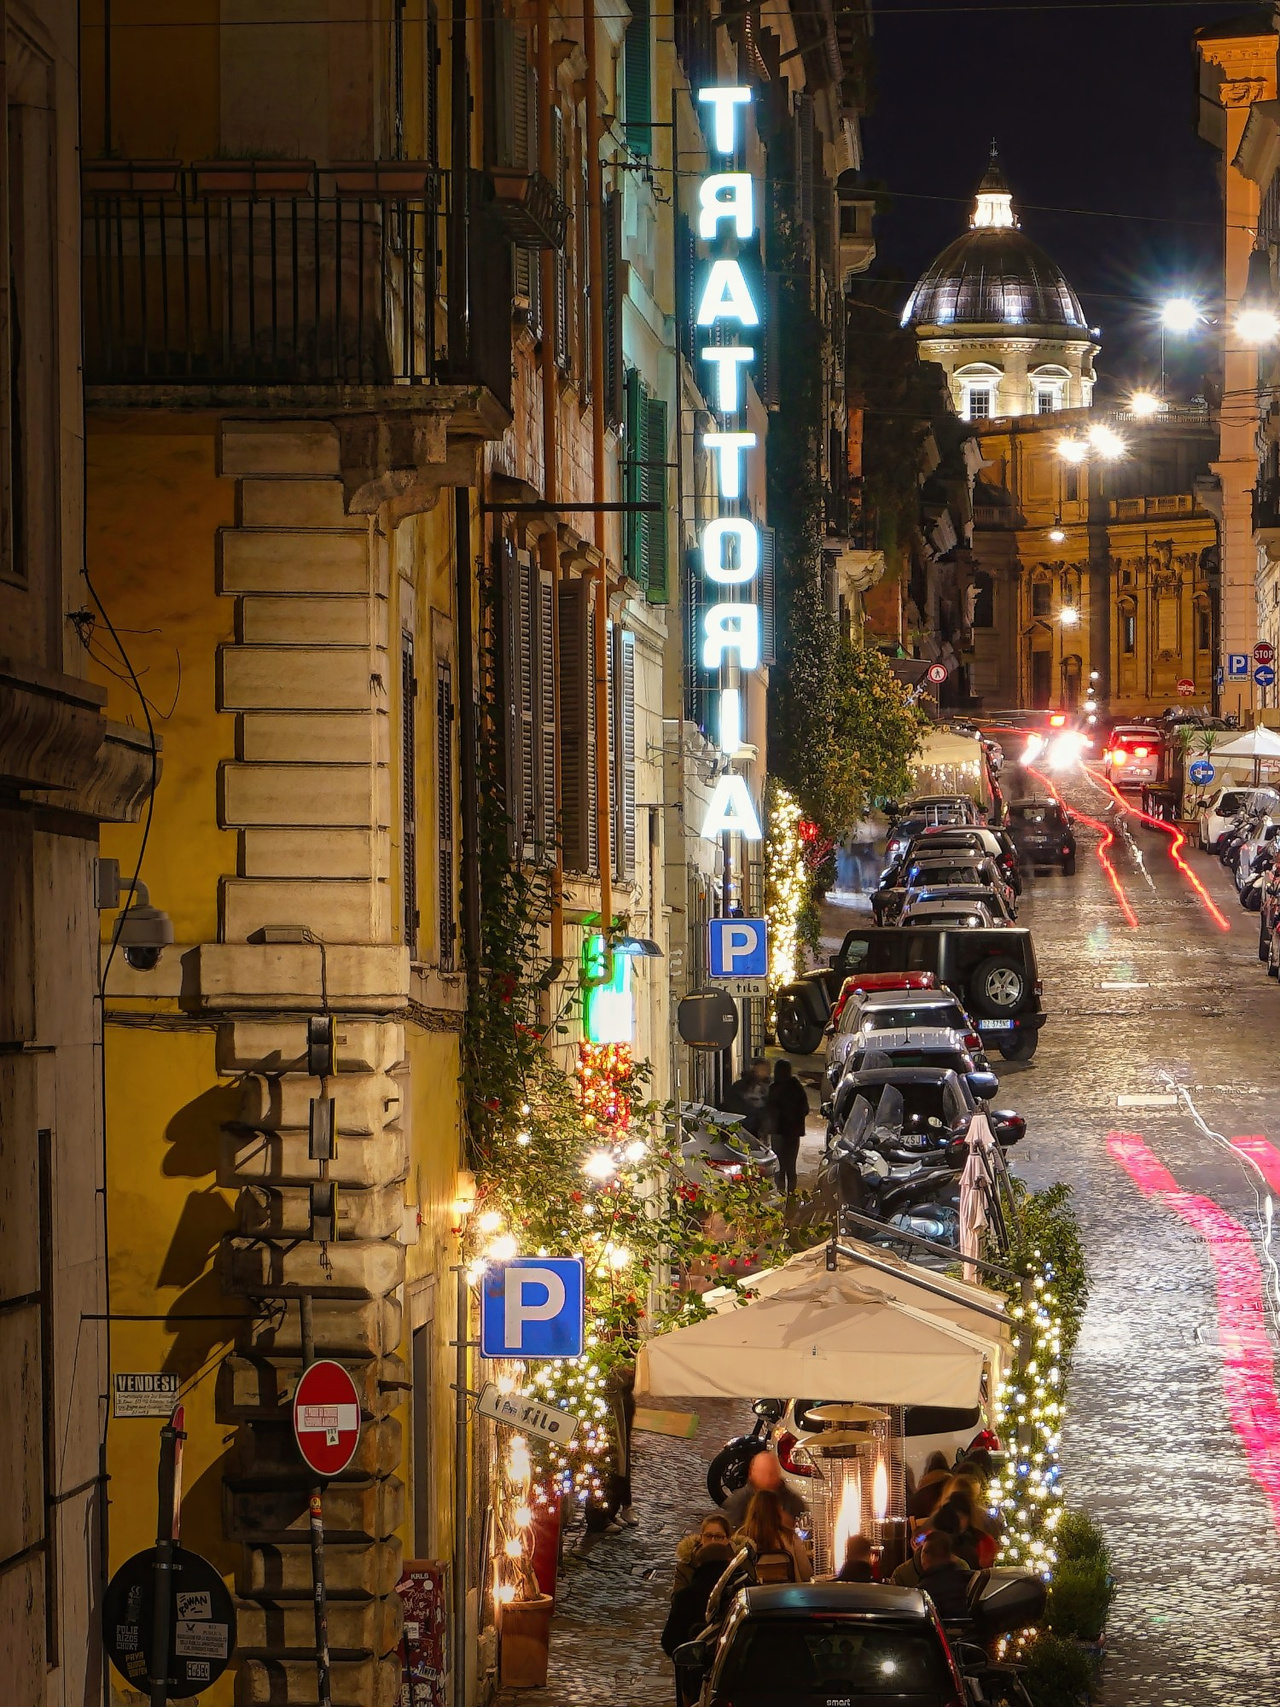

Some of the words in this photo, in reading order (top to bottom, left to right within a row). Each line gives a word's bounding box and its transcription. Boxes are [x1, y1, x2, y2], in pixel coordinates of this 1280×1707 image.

[1232, 656, 1245, 673] P
[1254, 650, 1273, 659] STOP
[722, 924, 758, 972] P
[505, 1268, 566, 1349] P
[117, 1375, 175, 1391] VENDESI
[178, 1594, 208, 1618] ROWAN
